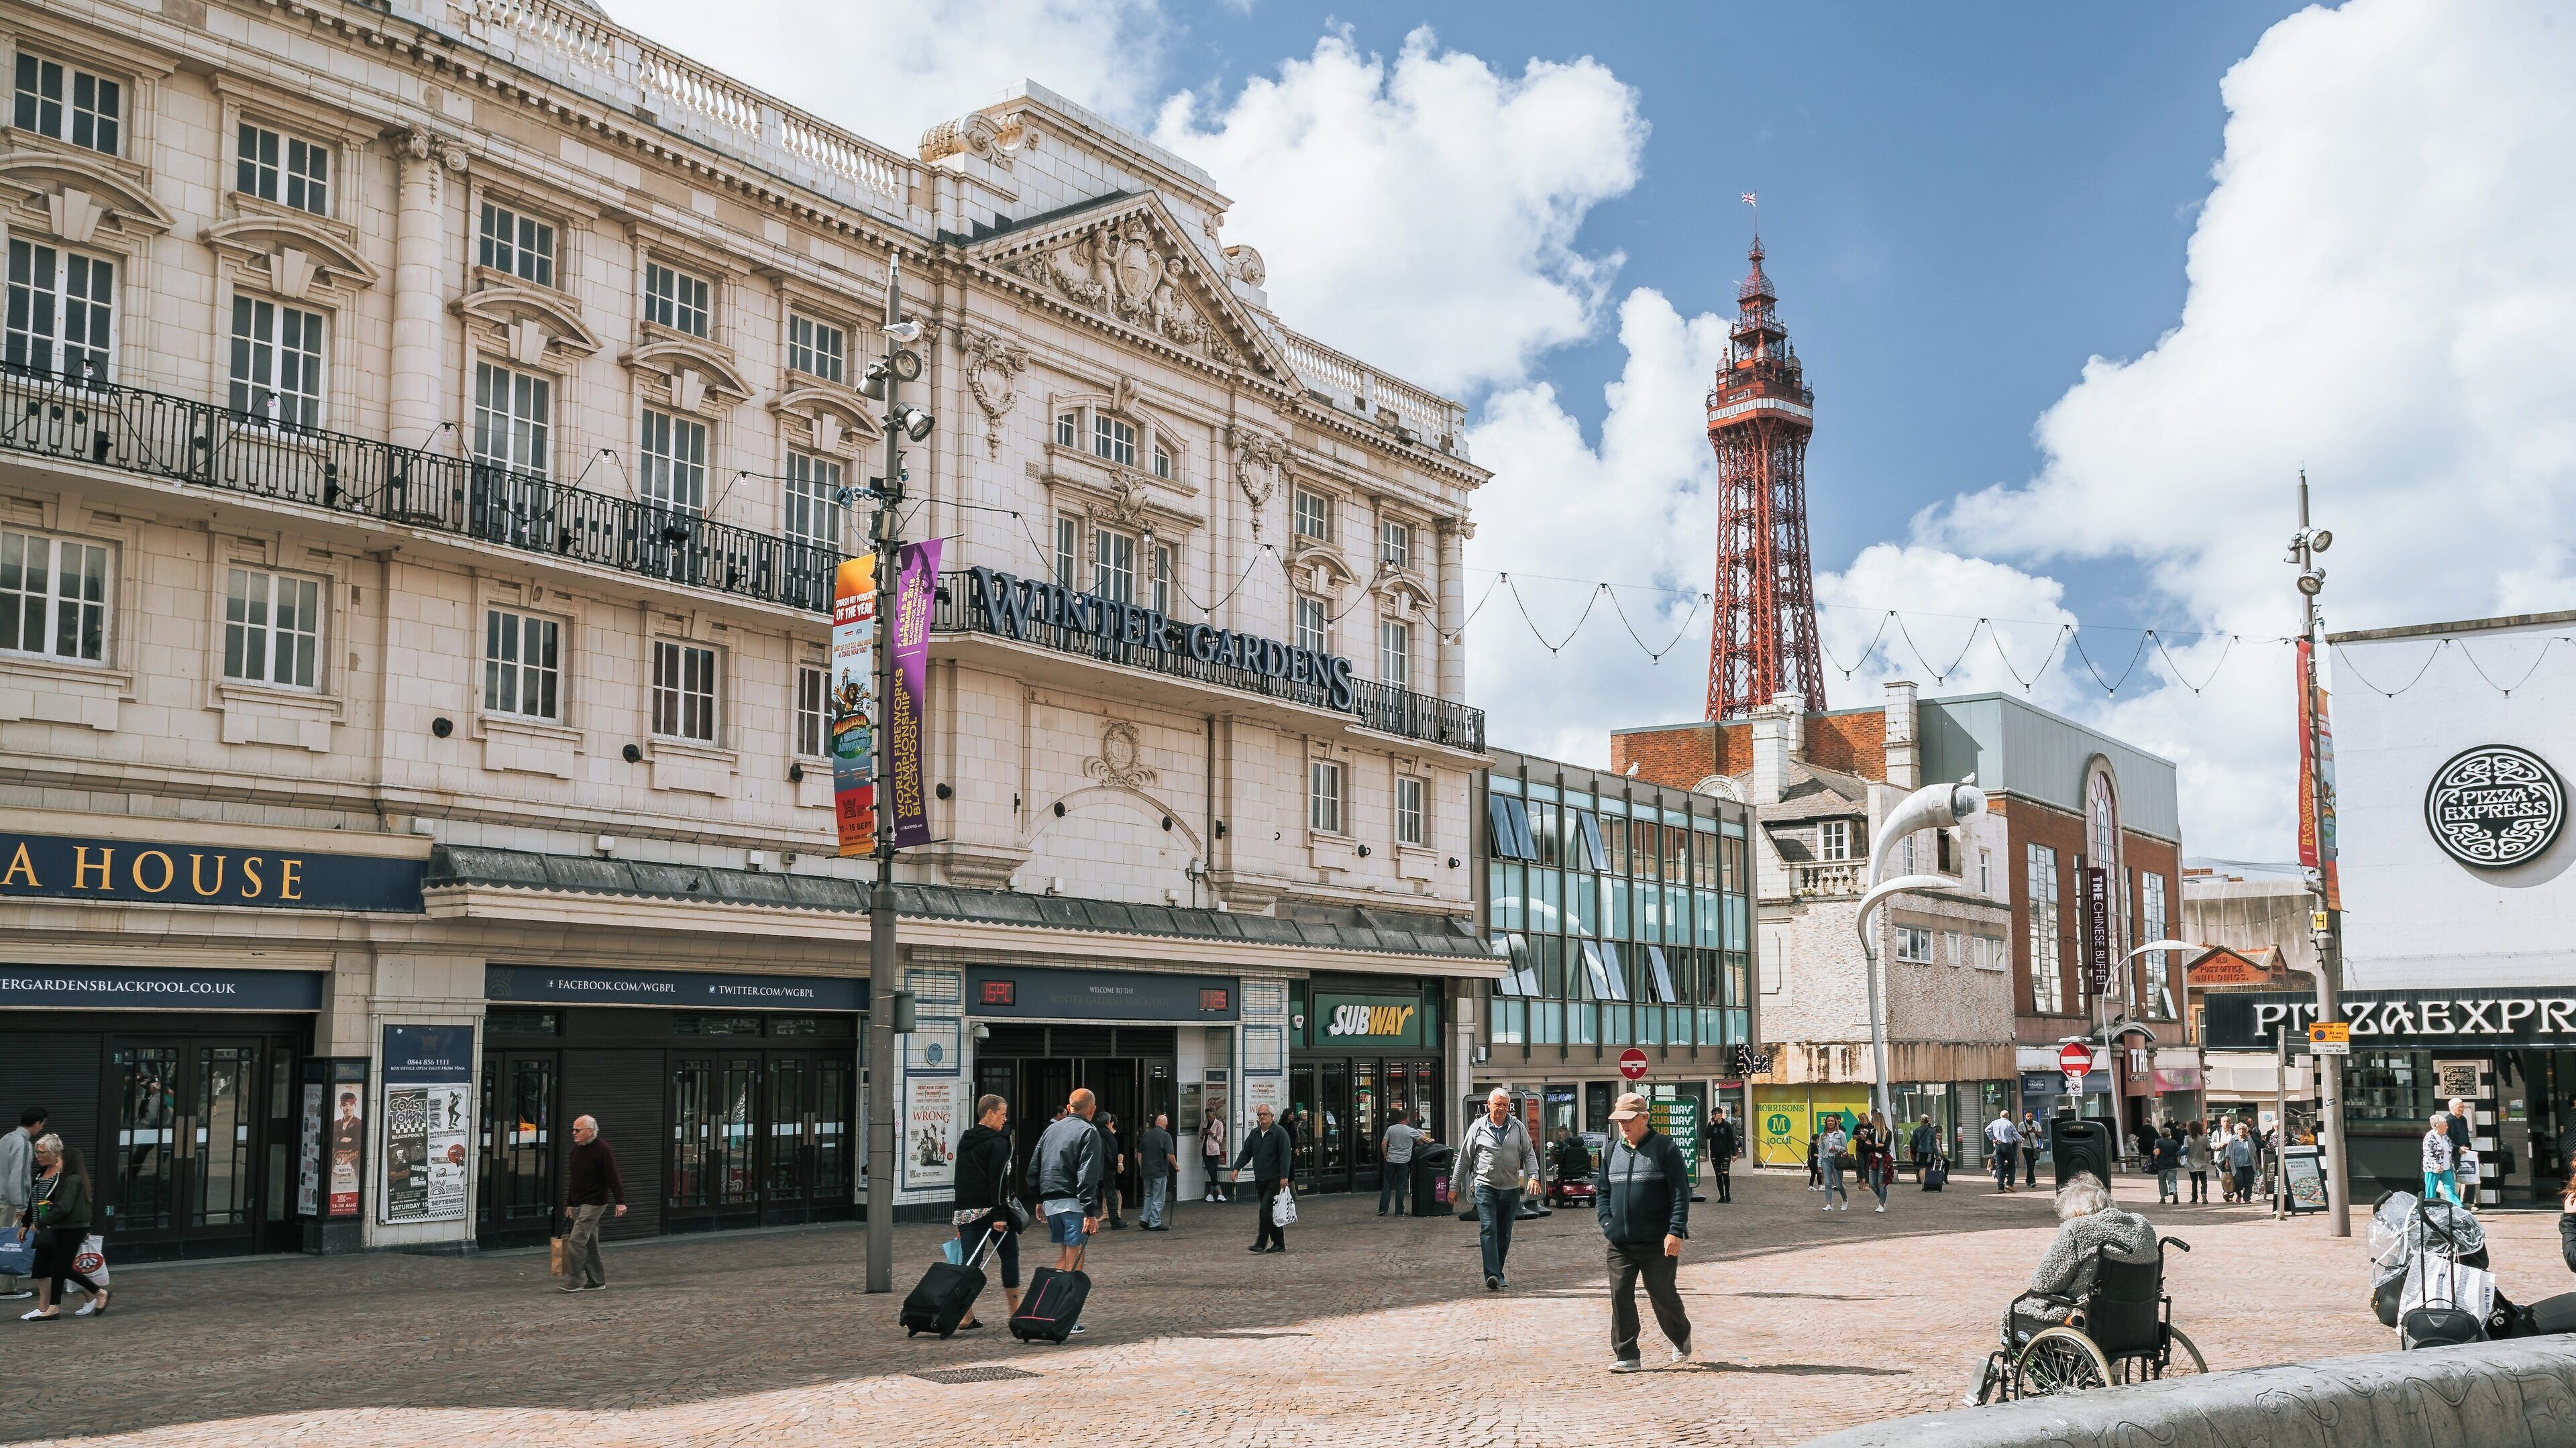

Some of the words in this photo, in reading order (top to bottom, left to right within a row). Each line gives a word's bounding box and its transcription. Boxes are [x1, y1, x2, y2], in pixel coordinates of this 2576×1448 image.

[835, 597, 849, 608] SMASH
[836, 608, 845, 621] OF
[845, 604, 857, 620] THE
[857, 602, 873, 616] YEAR
[902, 600, 913, 647] SEPTEMBER
[908, 578, 916, 599] 2018
[908, 607, 916, 645] BLACKPOOL
[971, 565, 1171, 653] WINTER
[1187, 622, 1354, 710] GARDENS
[894, 667, 904, 757] FIREWORKS
[833, 715, 867, 736] MADAGASCAR
[843, 728, 869, 742] MUSICAL
[838, 738, 871, 752] ADVENTURE
[902, 691, 913, 817] CHAMPIONSHIP
[909, 716, 921, 815] BLACKPOOL
[895, 761, 906, 819] WORLD
[2461, 787, 2528, 805] PIZZA
[2444, 801, 2548, 821] EXPRESS
[857, 821, 872, 830] SEPT
[71, 846, 302, 900] HOUSE
[2092, 875, 2104, 901] THE
[2095, 951, 2106, 985] BUFFET
[0, 979, 236, 994] ERGARDENSBLACKPOOL.CO.UK
[557, 980, 676, 993] FACEBOOK.COM/WGBPL
[718, 985, 814, 998] TWITTER.COM/WGBPL
[1089, 986, 1115, 994] WELCOME
[1051, 995, 1084, 1004] WINTER
[1085, 995, 1122, 1005] GARDENS
[1327, 1005, 1414, 1037] SUBWAY
[1743, 1044, 1771, 1073] Sea
[1546, 1093, 1558, 1102] TAKE
[389, 1098, 428, 1112] COAST
[1651, 1105, 1694, 1115] SUBWAY
[1755, 1104, 1805, 1112] MORRISONS
[389, 1111, 427, 1125] TOWN
[429, 1099, 442, 1129] 2018
[912, 1111, 951, 1124] WRONG
[1651, 1115, 1695, 1125] SUBWAY
[1771, 1117, 1786, 1131] M
[1766, 1134, 1792, 1146] local
[390, 1203, 421, 1211] SATURDAY
[431, 1197, 464, 1206] SEPTEMBER
